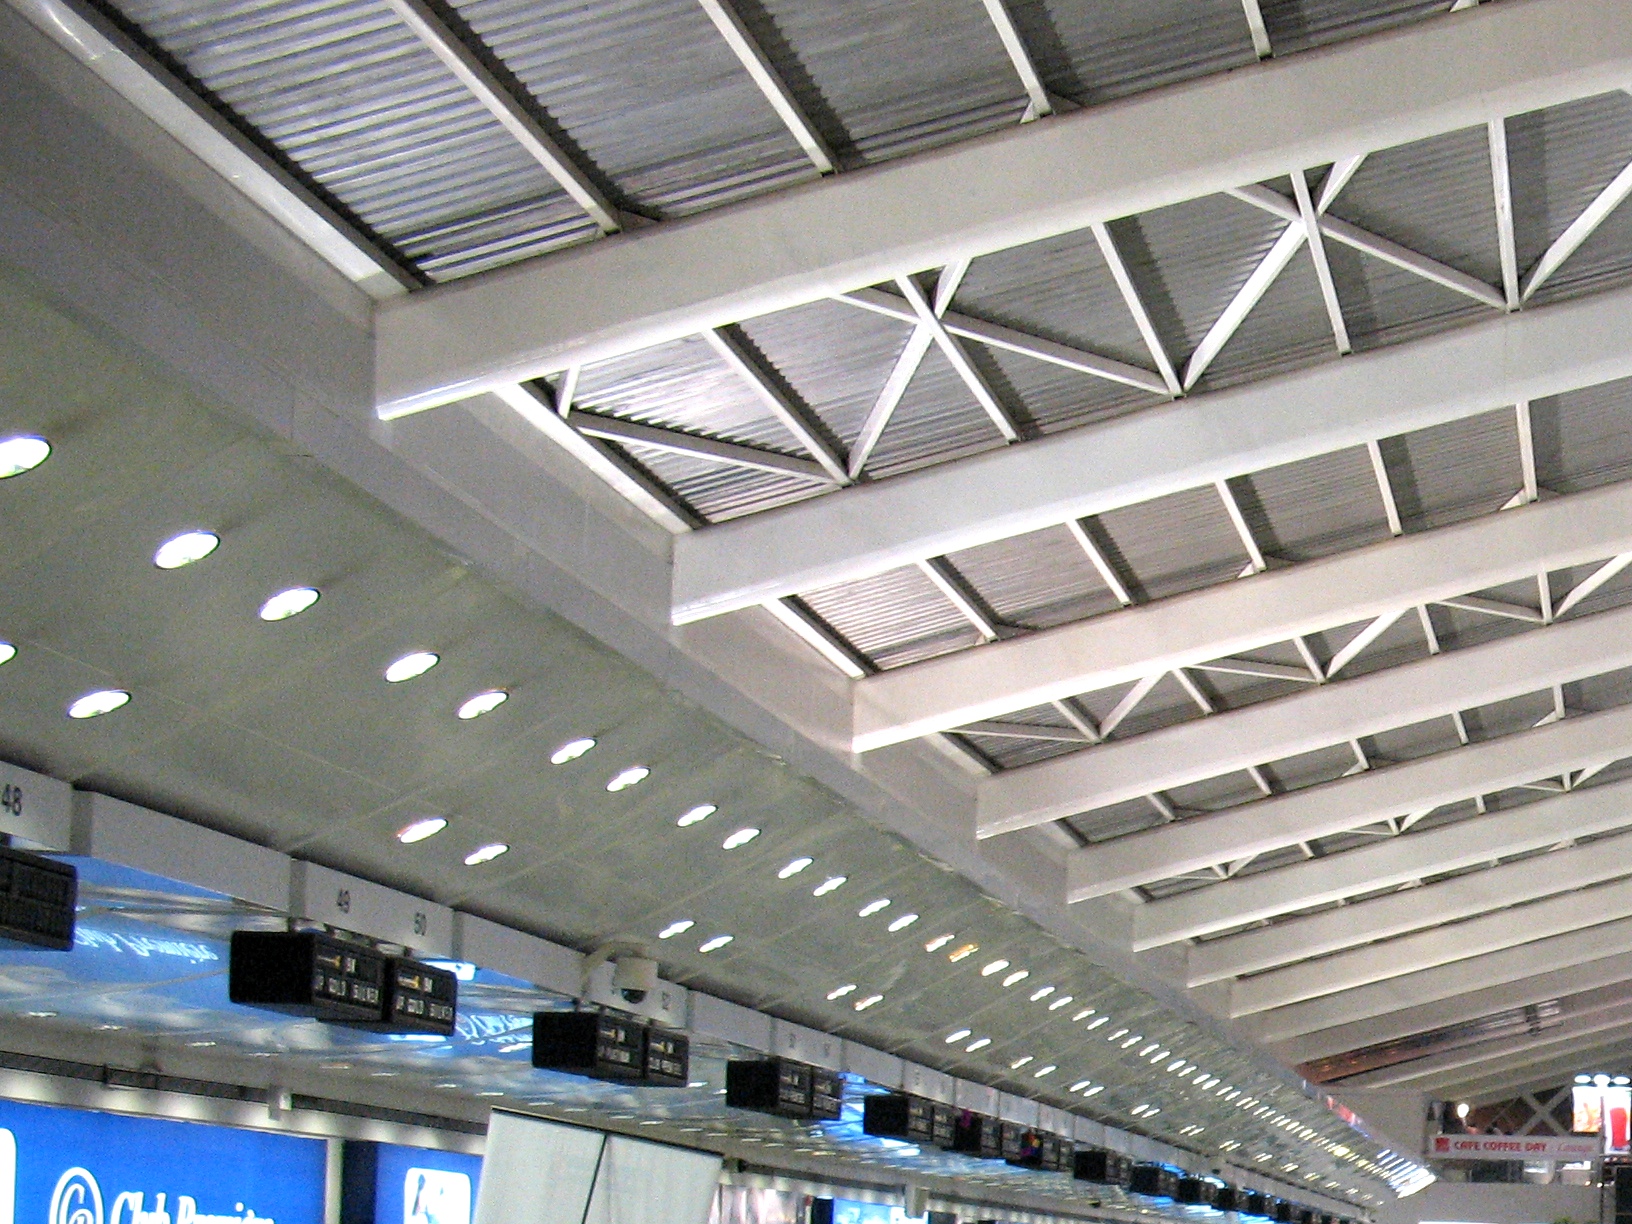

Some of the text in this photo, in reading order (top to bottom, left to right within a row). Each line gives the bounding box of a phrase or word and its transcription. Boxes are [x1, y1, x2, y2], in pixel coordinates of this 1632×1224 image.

[1, 783, 23, 816] 48
[336, 888, 351, 914] 49
[1483, 1141, 1521, 1152] COFFEE
[1525, 1142, 1547, 1152] DAY
